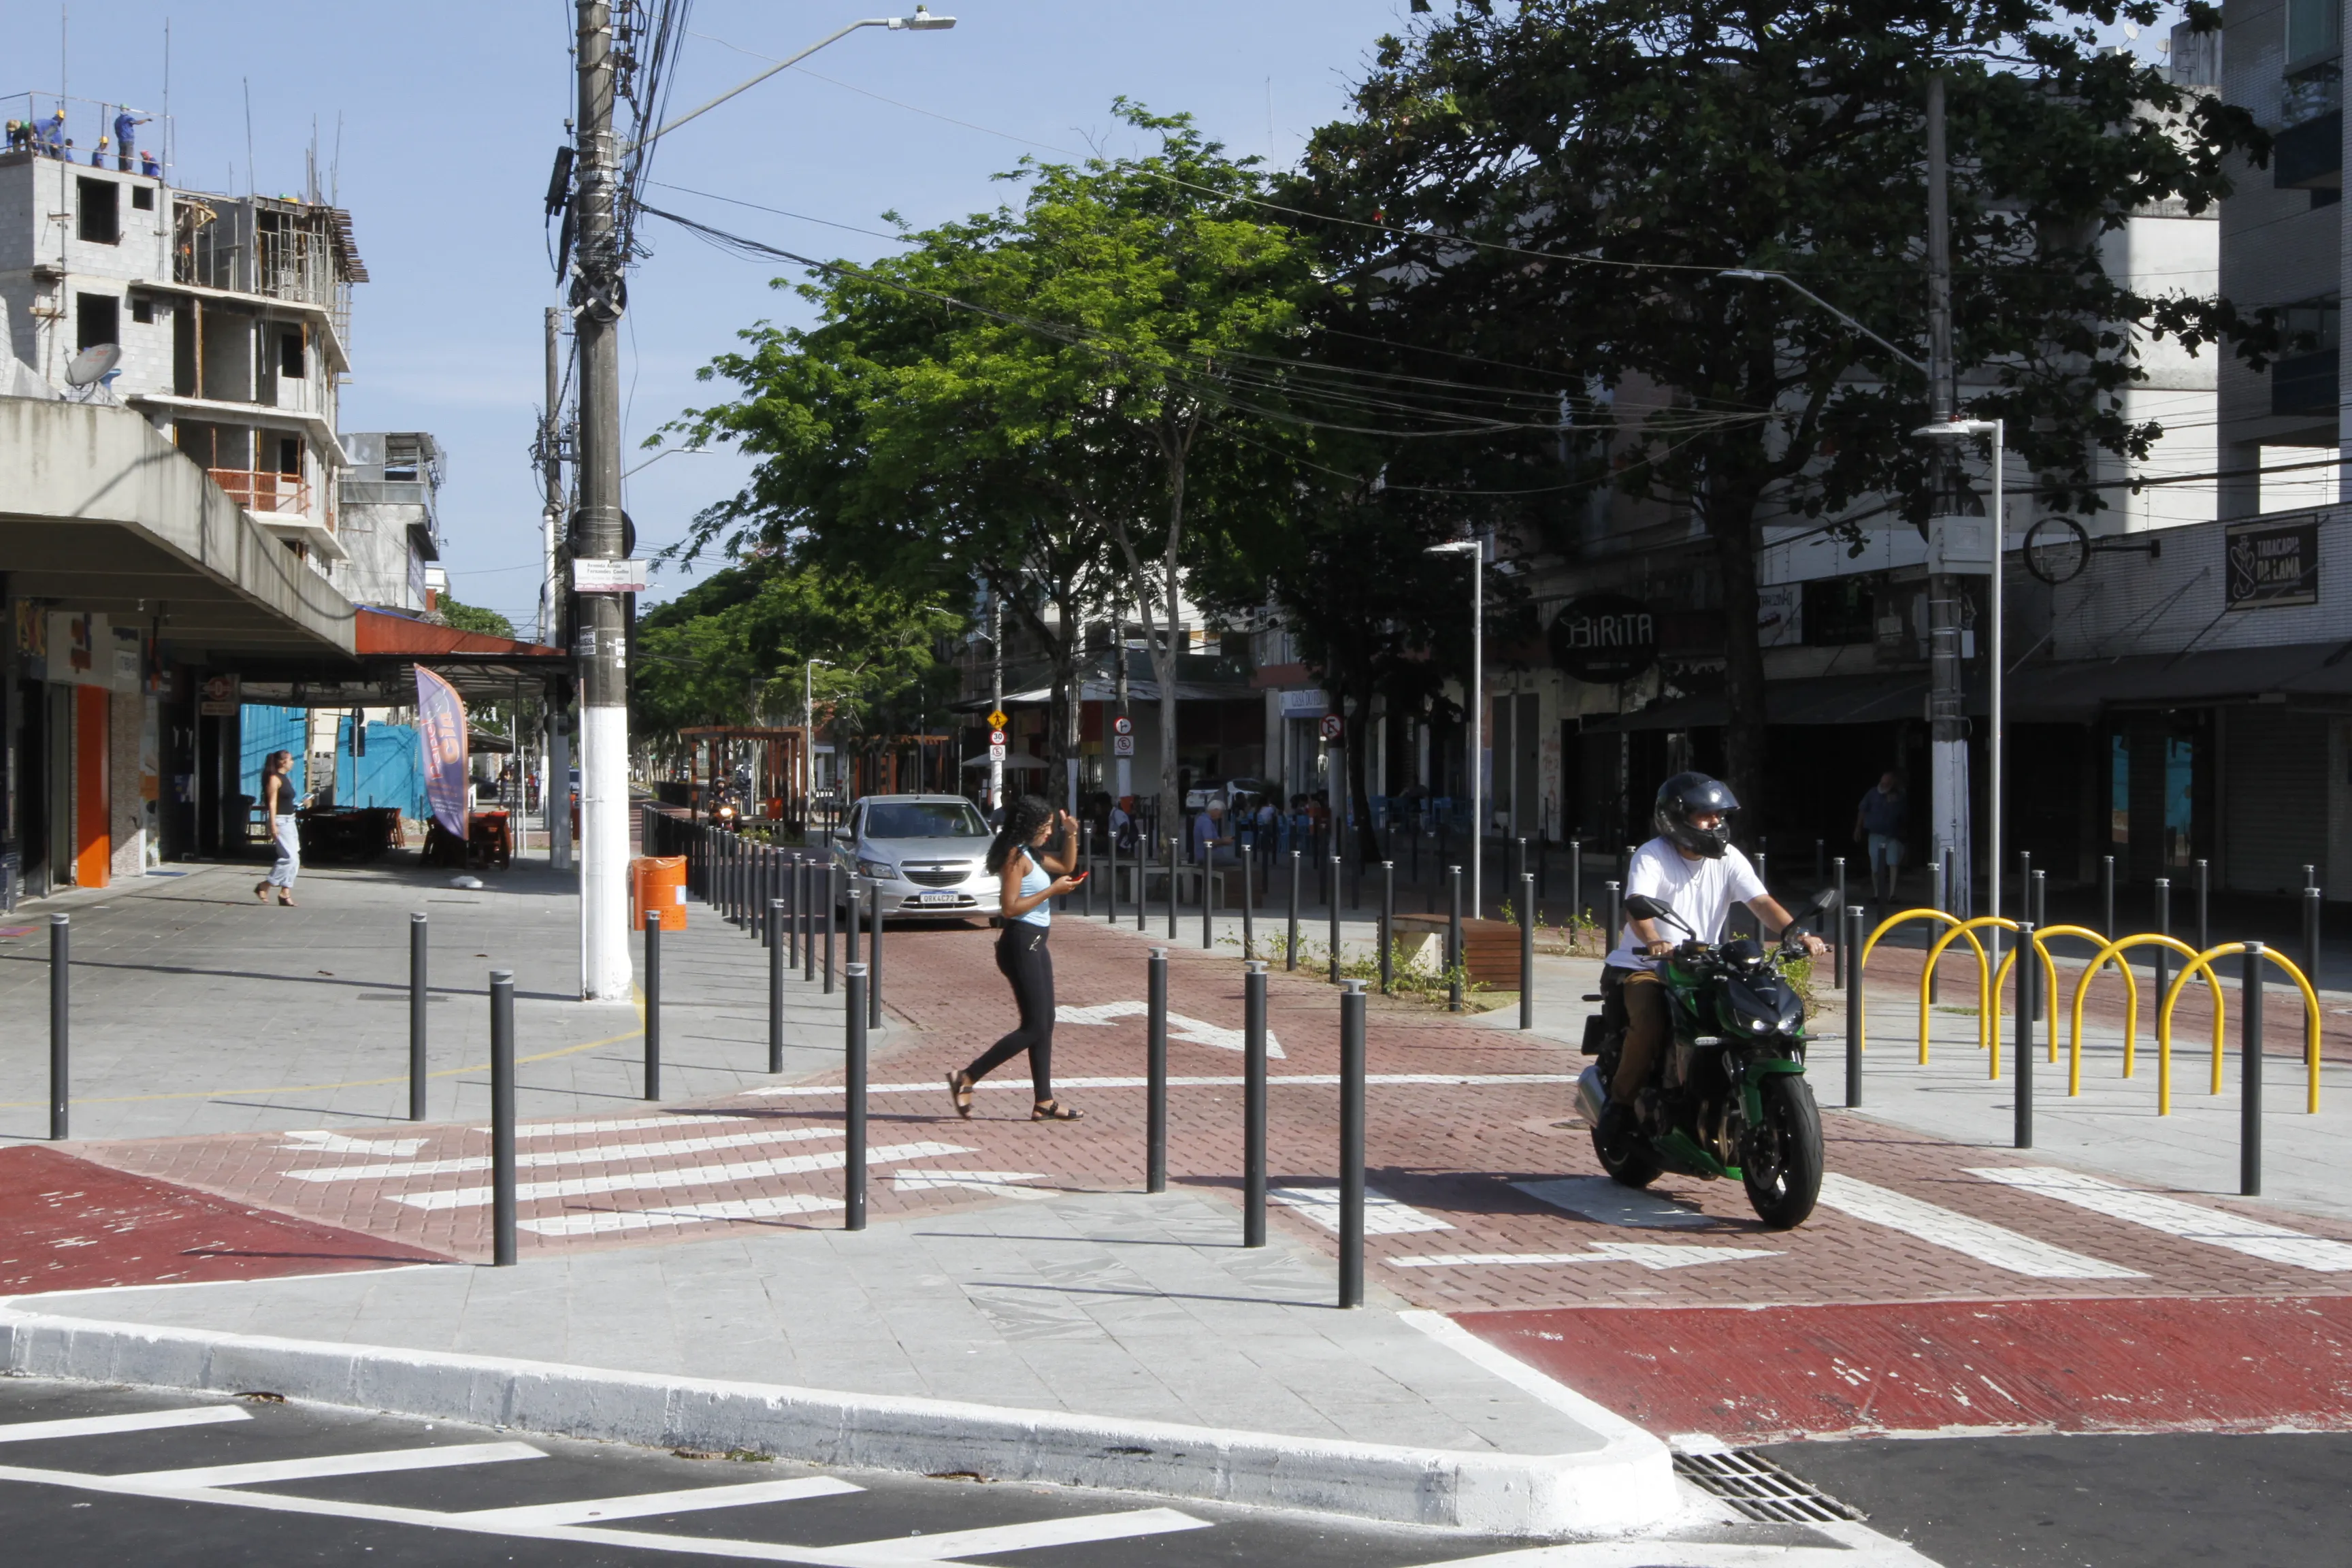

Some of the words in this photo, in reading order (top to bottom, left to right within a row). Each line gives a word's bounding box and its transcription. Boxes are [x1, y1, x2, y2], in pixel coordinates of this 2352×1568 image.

[2257, 536, 2300, 557] TABACARIA
[2257, 559, 2270, 581] DA
[2272, 556, 2300, 580] LAMA
[1292, 692, 1305, 706] CASA
